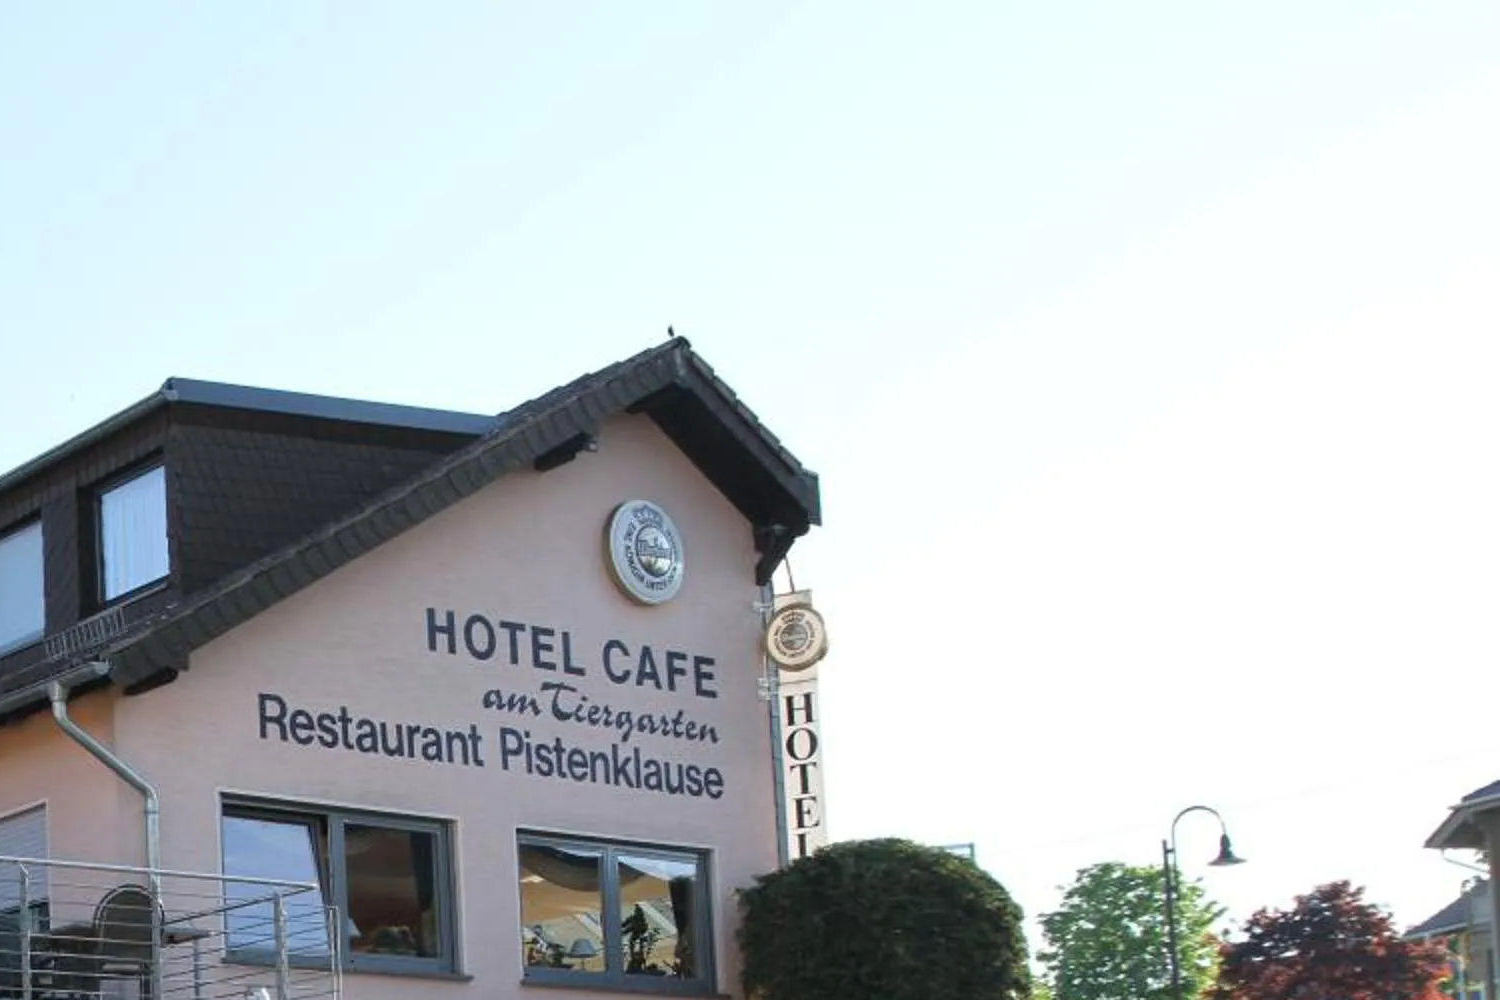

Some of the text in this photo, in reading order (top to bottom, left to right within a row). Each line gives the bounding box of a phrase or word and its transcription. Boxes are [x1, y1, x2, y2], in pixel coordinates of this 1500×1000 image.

[426, 607, 586, 676] HOTEL
[603, 639, 719, 698] CAFE
[258, 692, 725, 799] Restaurant Pistenklause
[482, 681, 720, 744] am Tiergarten
